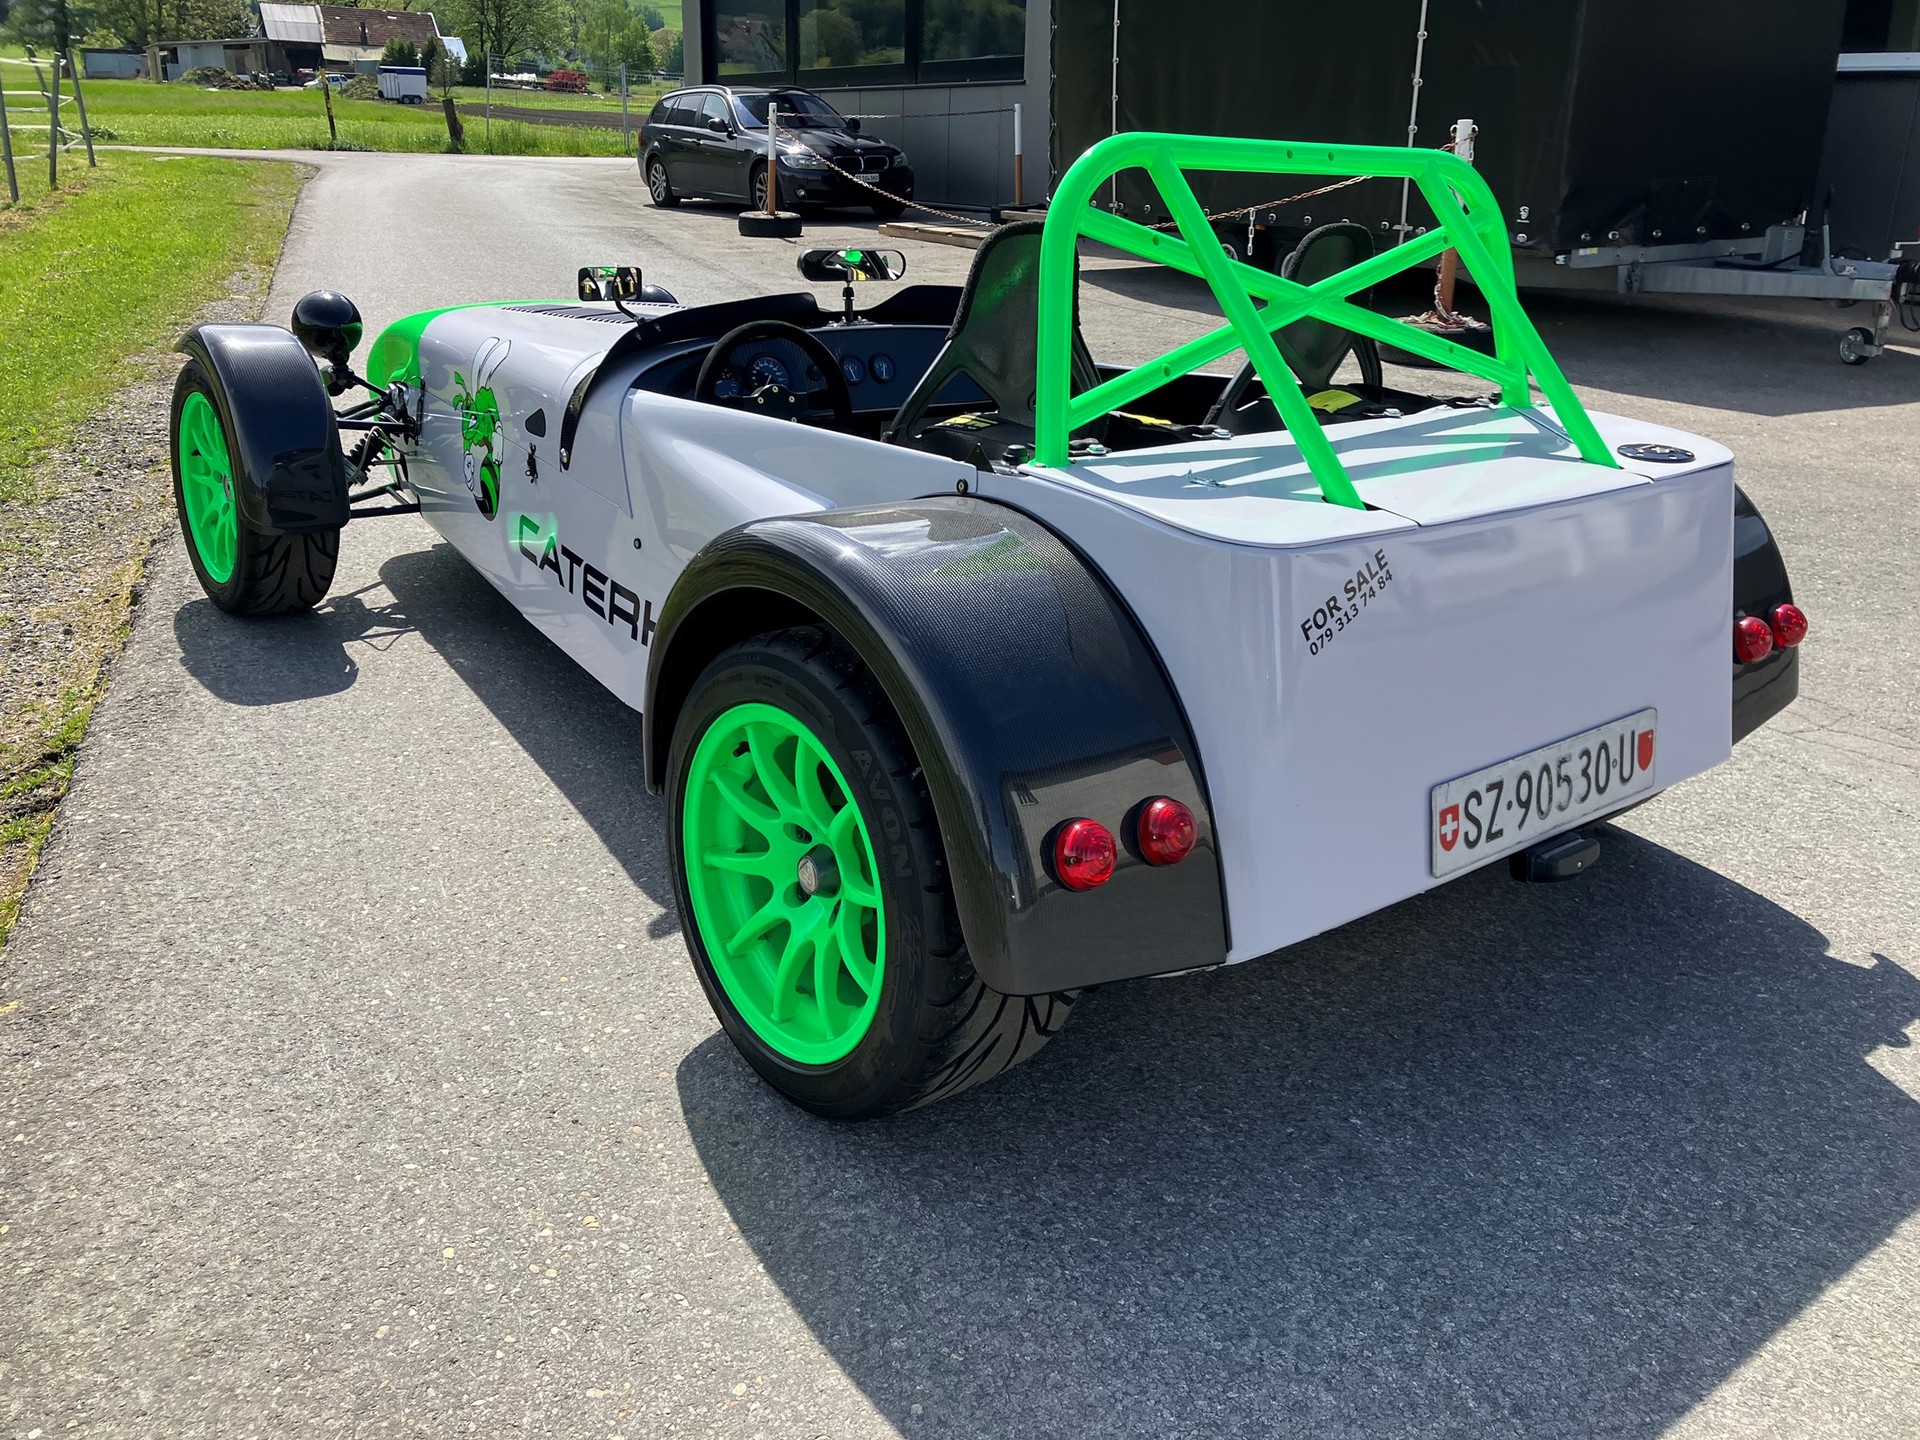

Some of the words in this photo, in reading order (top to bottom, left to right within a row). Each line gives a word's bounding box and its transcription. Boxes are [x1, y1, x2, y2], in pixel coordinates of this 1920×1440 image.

[1300, 595, 1342, 641] FOR
[1343, 548, 1389, 602] SALE
[1309, 628, 1333, 656] 079
[1335, 603, 1359, 632] 313
[1360, 586, 1376, 607] 74
[1377, 569, 1393, 590] 84
[850, 749, 913, 878] AVON
